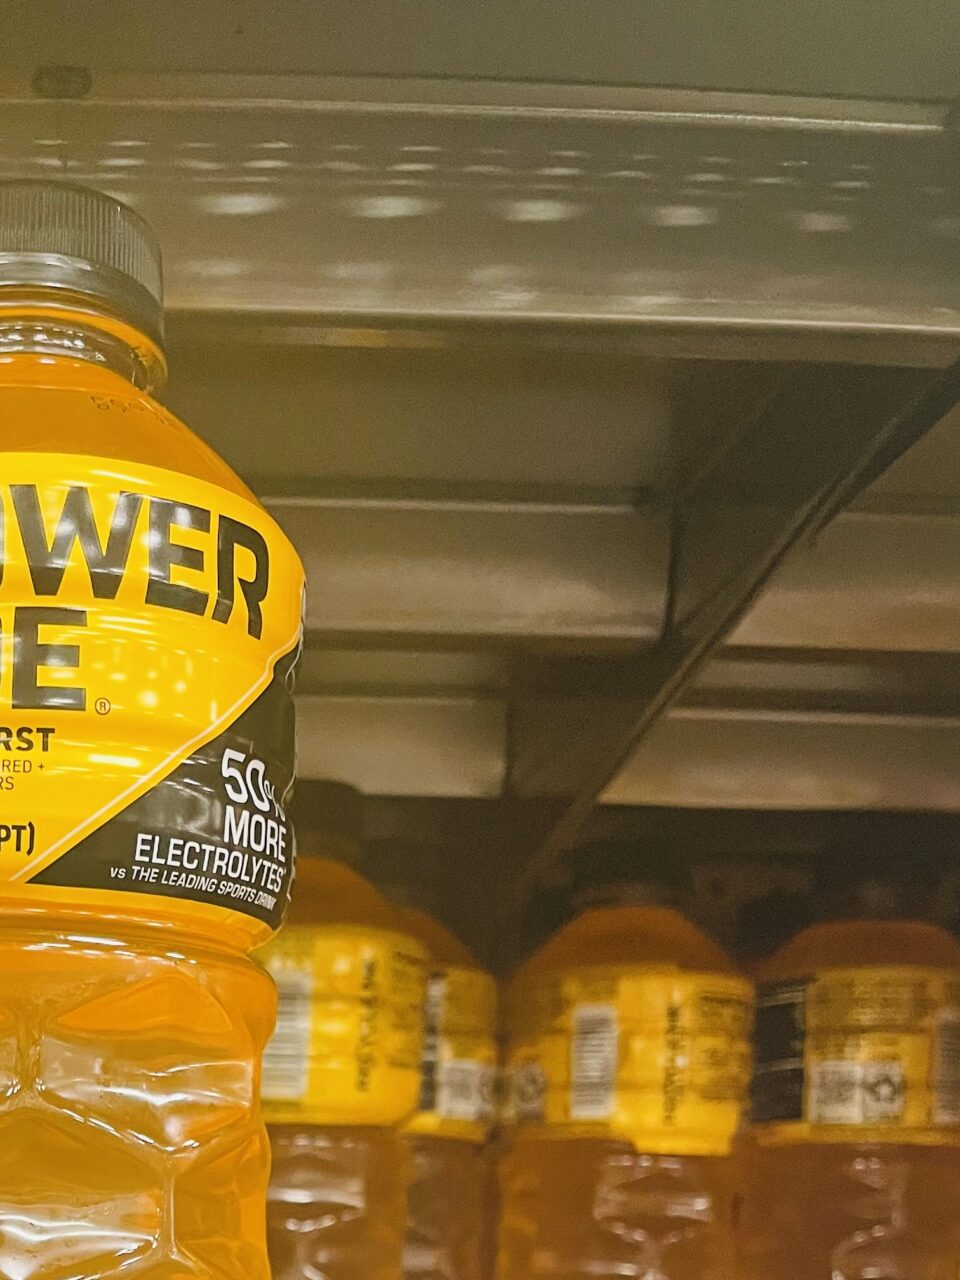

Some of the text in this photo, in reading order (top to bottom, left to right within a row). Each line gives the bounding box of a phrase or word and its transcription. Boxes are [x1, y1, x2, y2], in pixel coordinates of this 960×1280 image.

[221, 748, 286, 822] 50%
[223, 805, 288, 863] MORE
[110, 866, 126, 879] vs
[131, 865, 157, 884] THE
[161, 869, 217, 893] LEADING
[218, 881, 256, 902] SPORTS
